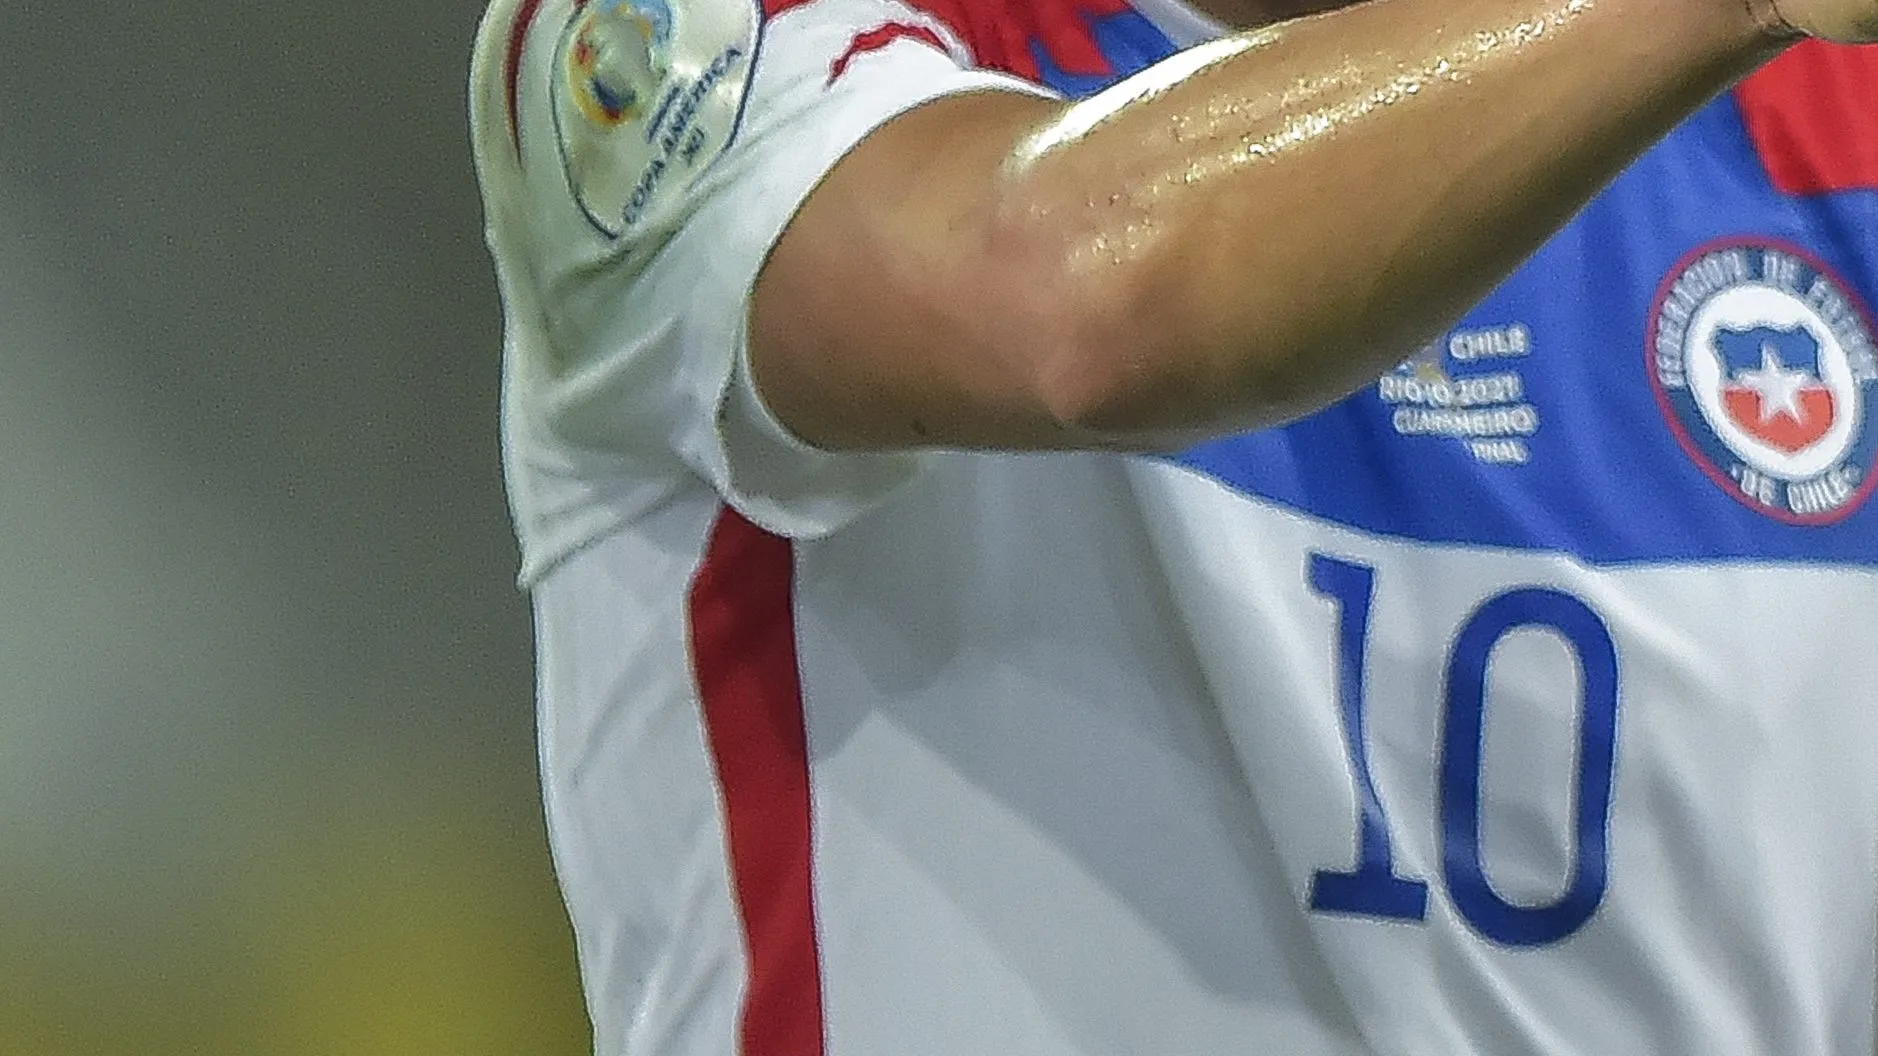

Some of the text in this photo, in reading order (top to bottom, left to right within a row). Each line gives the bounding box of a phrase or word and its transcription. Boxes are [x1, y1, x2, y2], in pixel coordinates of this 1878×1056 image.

[621, 160, 665, 225] COPA
[1450, 326, 1529, 360] CHILE
[1740, 468, 1850, 514] DE CHILE
[1308, 551, 1619, 951] 10
